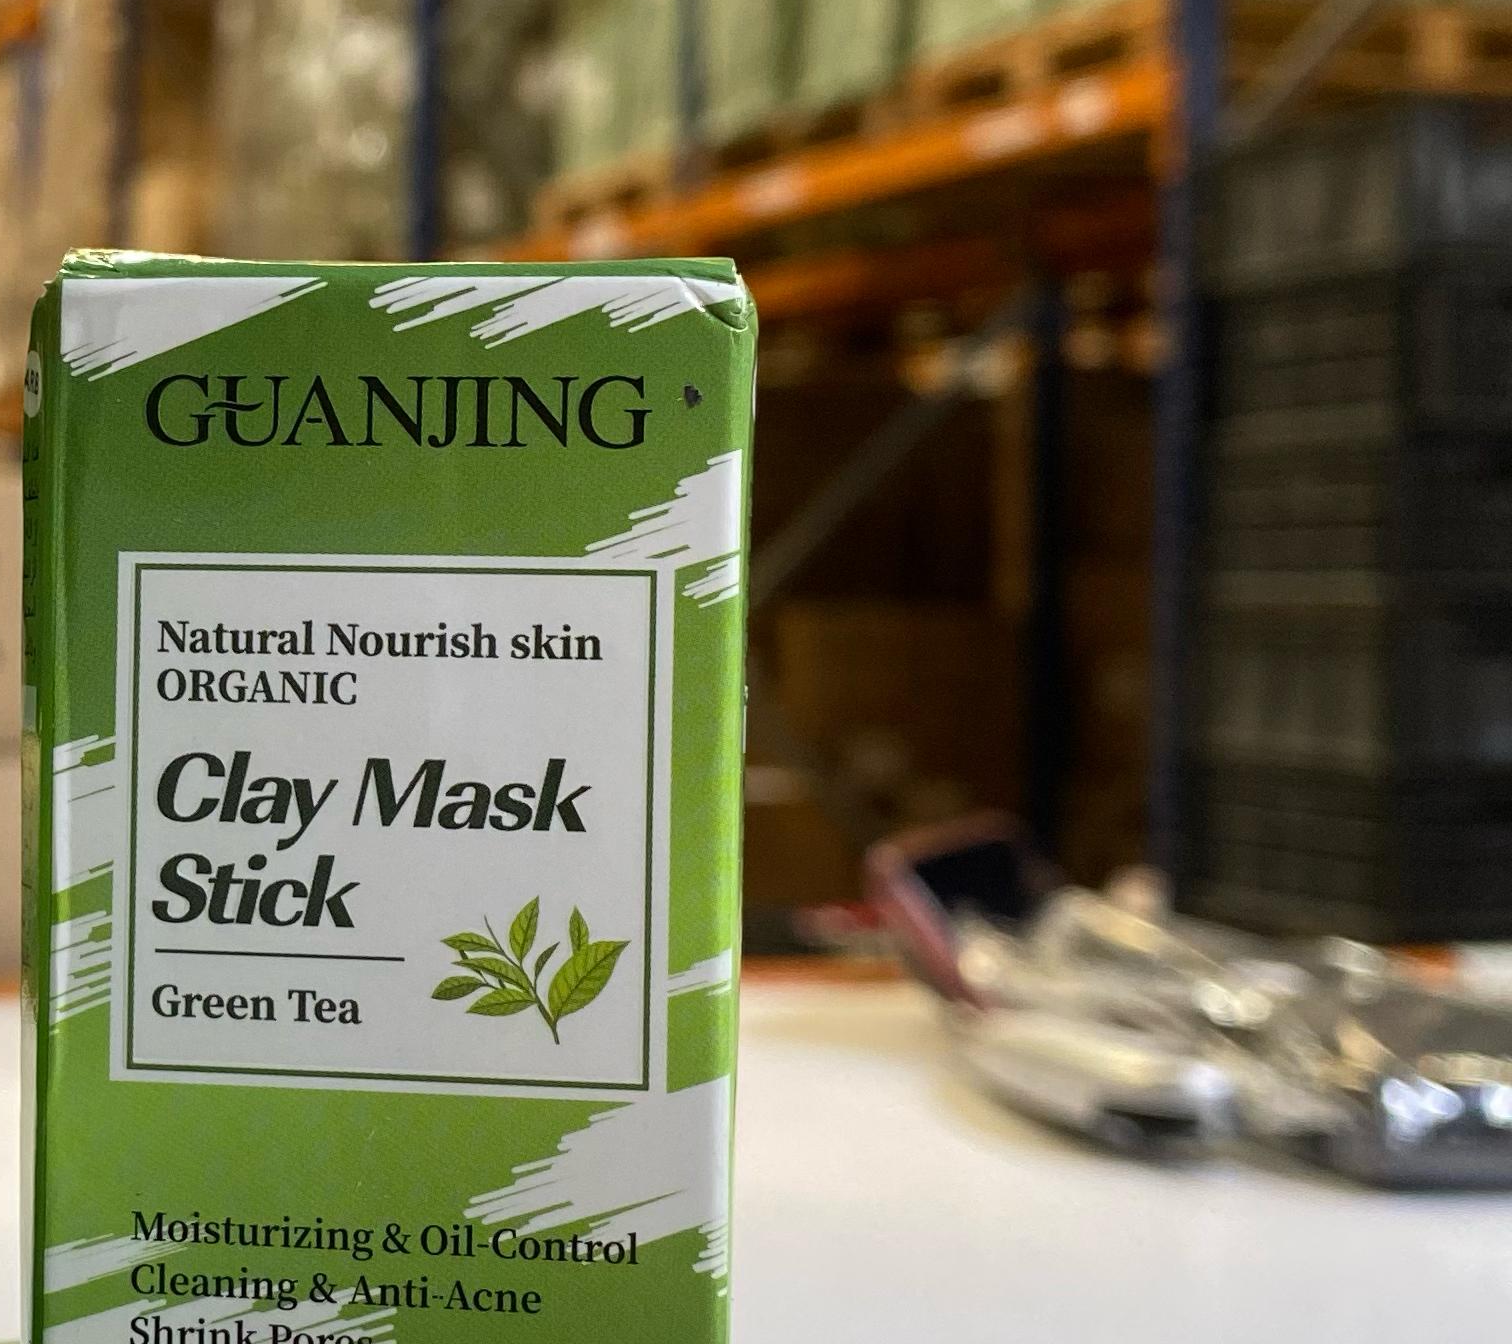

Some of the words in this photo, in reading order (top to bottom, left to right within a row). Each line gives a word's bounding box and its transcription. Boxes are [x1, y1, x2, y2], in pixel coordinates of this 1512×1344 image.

[145, 373, 652, 449] GUANJING
[157, 619, 314, 656] Natural
[326, 623, 498, 659] Nourish
[510, 624, 602, 661] skin
[156, 669, 358, 706] ORGANIC
[157, 751, 338, 850] Clay
[352, 757, 592, 832] Mask
[151, 854, 359, 929] Stick
[151, 983, 277, 1023] Green
[288, 989, 362, 1025] Tea
[131, 1211, 373, 1260] Moisturizing
[381, 1223, 412, 1255] &
[420, 1223, 639, 1265] Oil-Control
[130, 1264, 299, 1310] Cleaning
[308, 1274, 338, 1304] &
[348, 1274, 542, 1314] Anti-Acne
